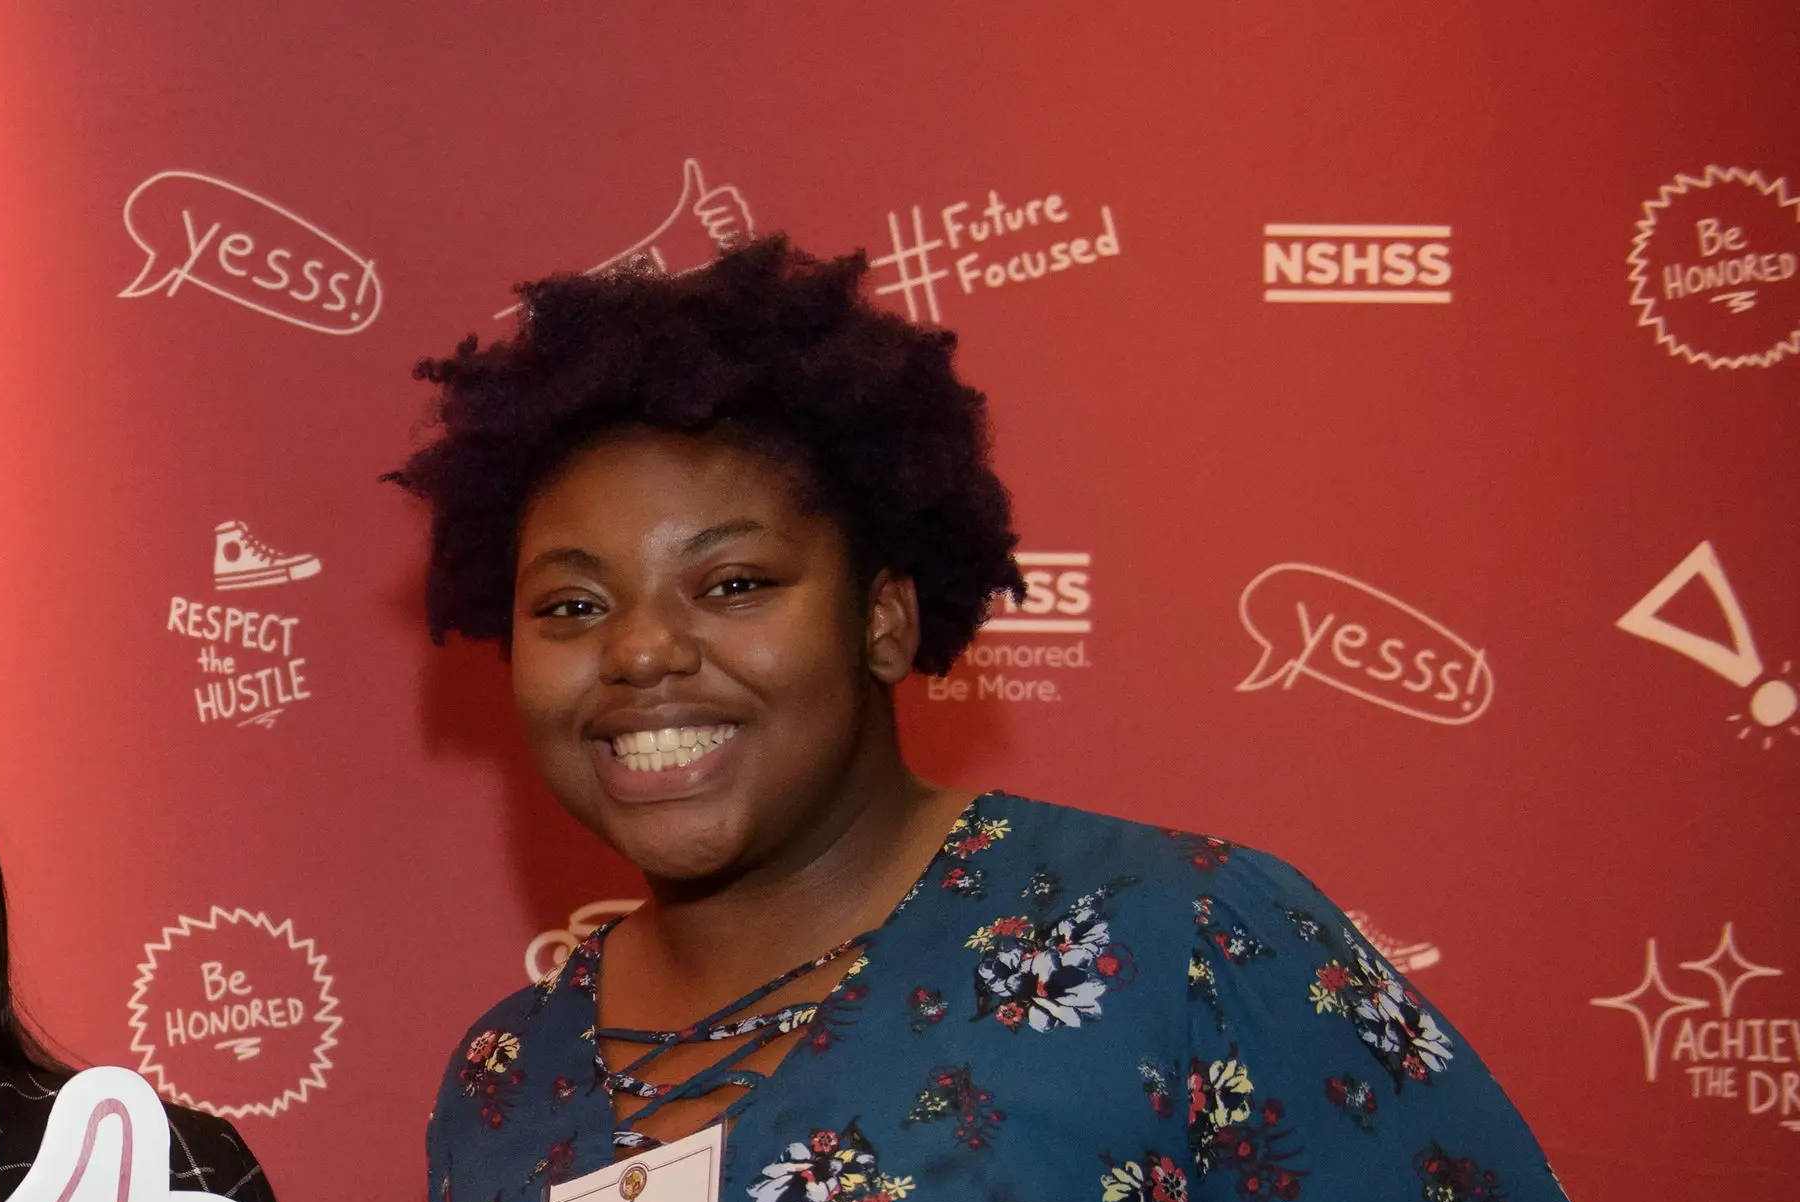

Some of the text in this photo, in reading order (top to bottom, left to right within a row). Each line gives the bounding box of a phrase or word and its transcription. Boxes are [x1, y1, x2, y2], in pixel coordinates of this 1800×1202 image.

[954, 205, 1120, 294] Focused
[1696, 218, 1747, 257] Be
[1265, 243, 1452, 286] NSHSS
[1663, 252, 1796, 299] HONORED
[167, 597, 299, 657] RESPECT
[198, 647, 235, 675] the
[194, 658, 310, 723] HUSTLE
[979, 674, 1062, 702] More.
[201, 961, 253, 1000] Be
[166, 998, 304, 1047] HONORED
[1685, 1066, 1738, 1098] THE
